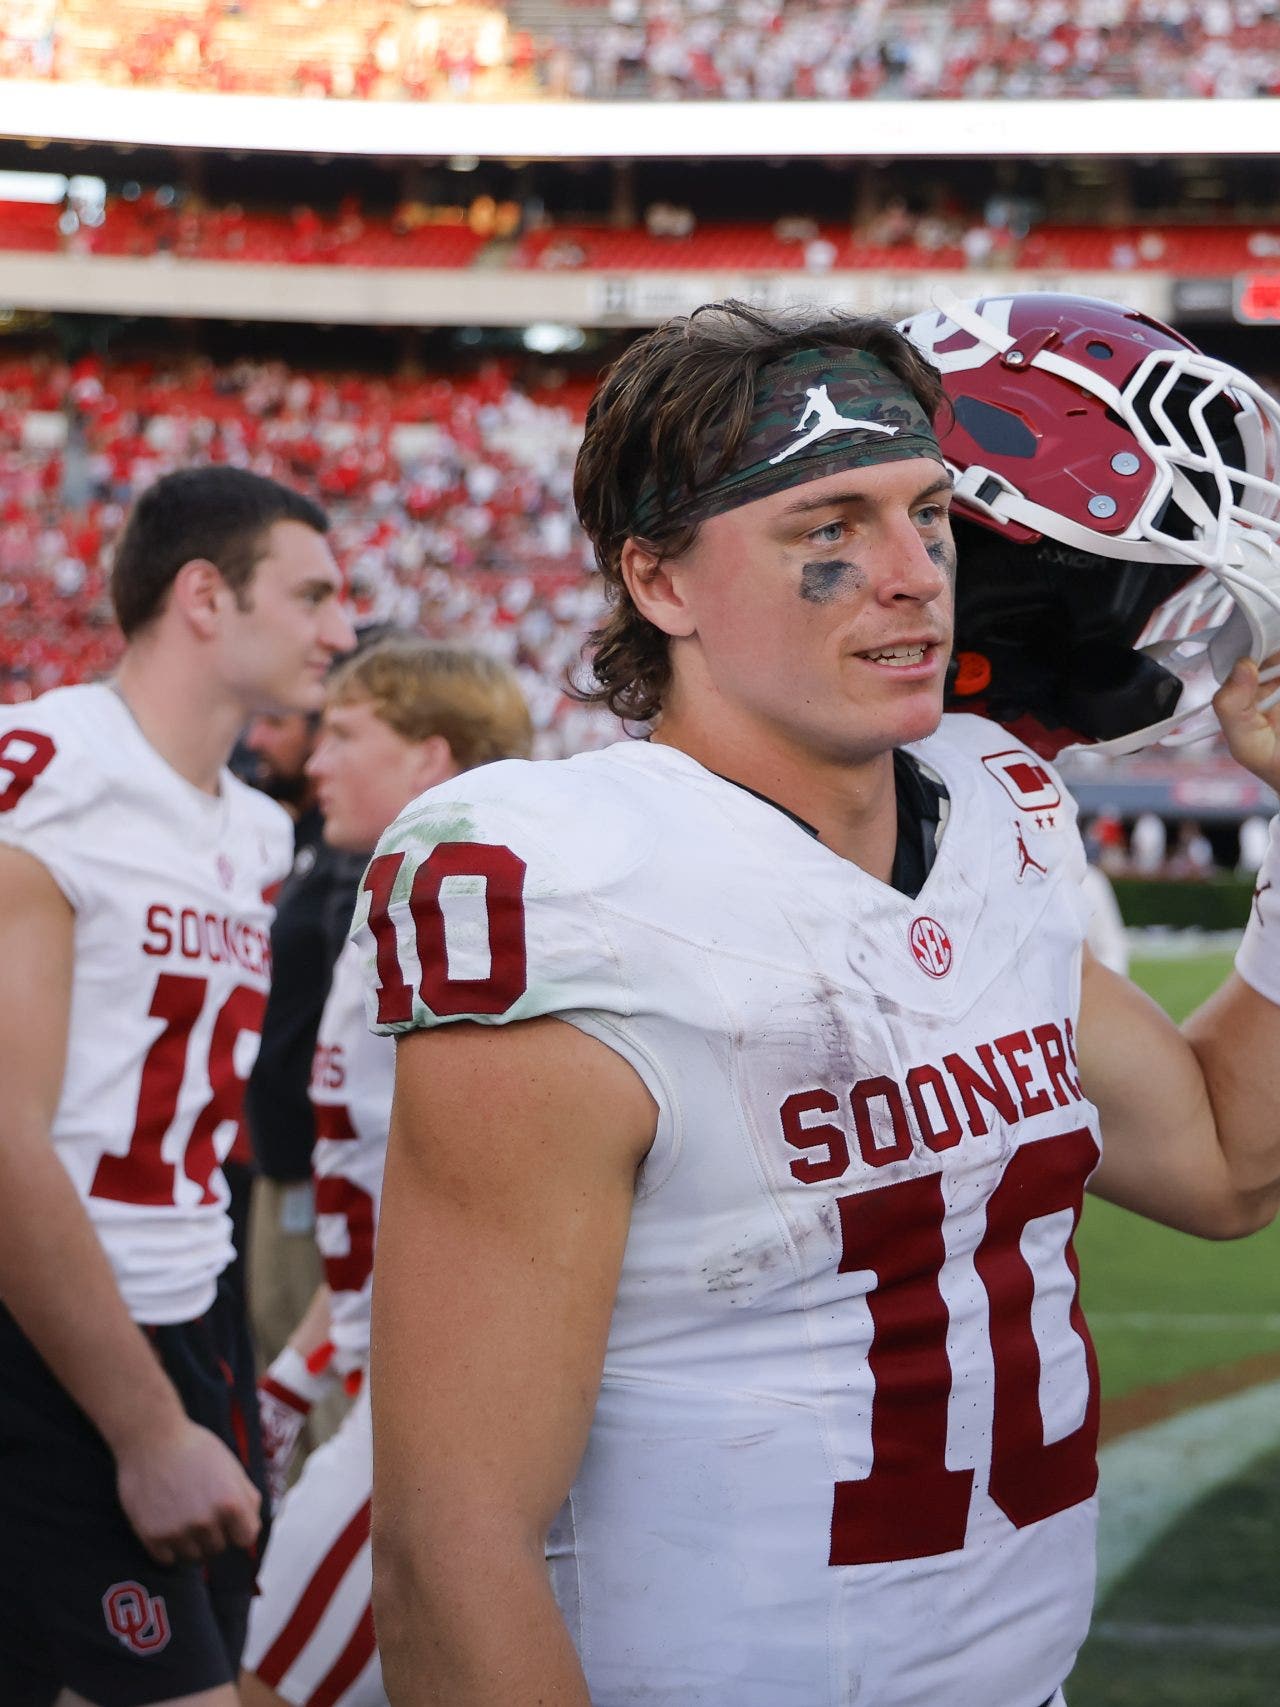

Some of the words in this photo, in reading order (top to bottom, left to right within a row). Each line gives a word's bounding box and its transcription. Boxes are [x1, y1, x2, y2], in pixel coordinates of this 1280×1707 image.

[363, 841, 528, 1024] 10
[912, 918, 951, 976] SEC
[828, 1126, 1101, 1567] 10
[101, 1581, 171, 1656] OU
